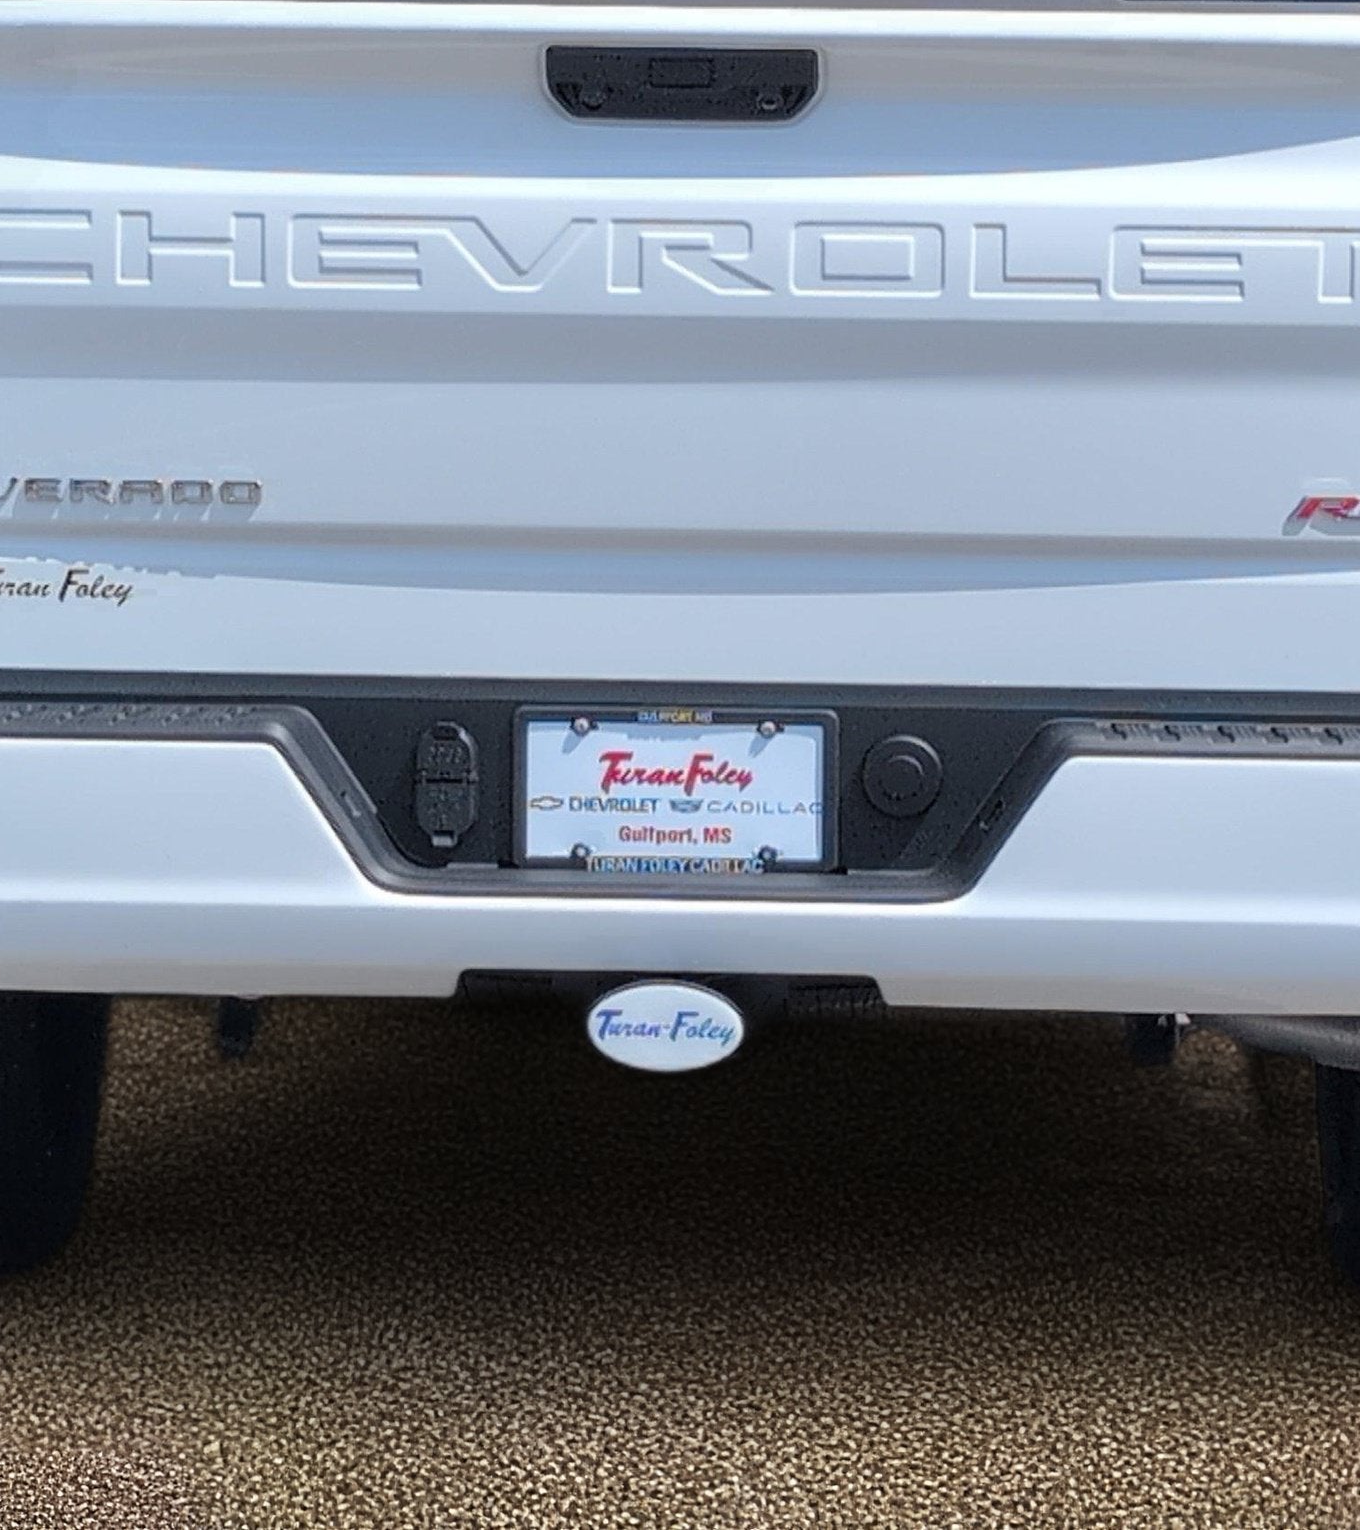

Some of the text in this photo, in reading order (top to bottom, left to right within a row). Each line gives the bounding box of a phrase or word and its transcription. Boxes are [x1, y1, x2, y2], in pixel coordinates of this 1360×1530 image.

[58, 568, 134, 608] Foley
[568, 796, 825, 815] CHEVROLET CADILLAC
[703, 826, 732, 844] MS
